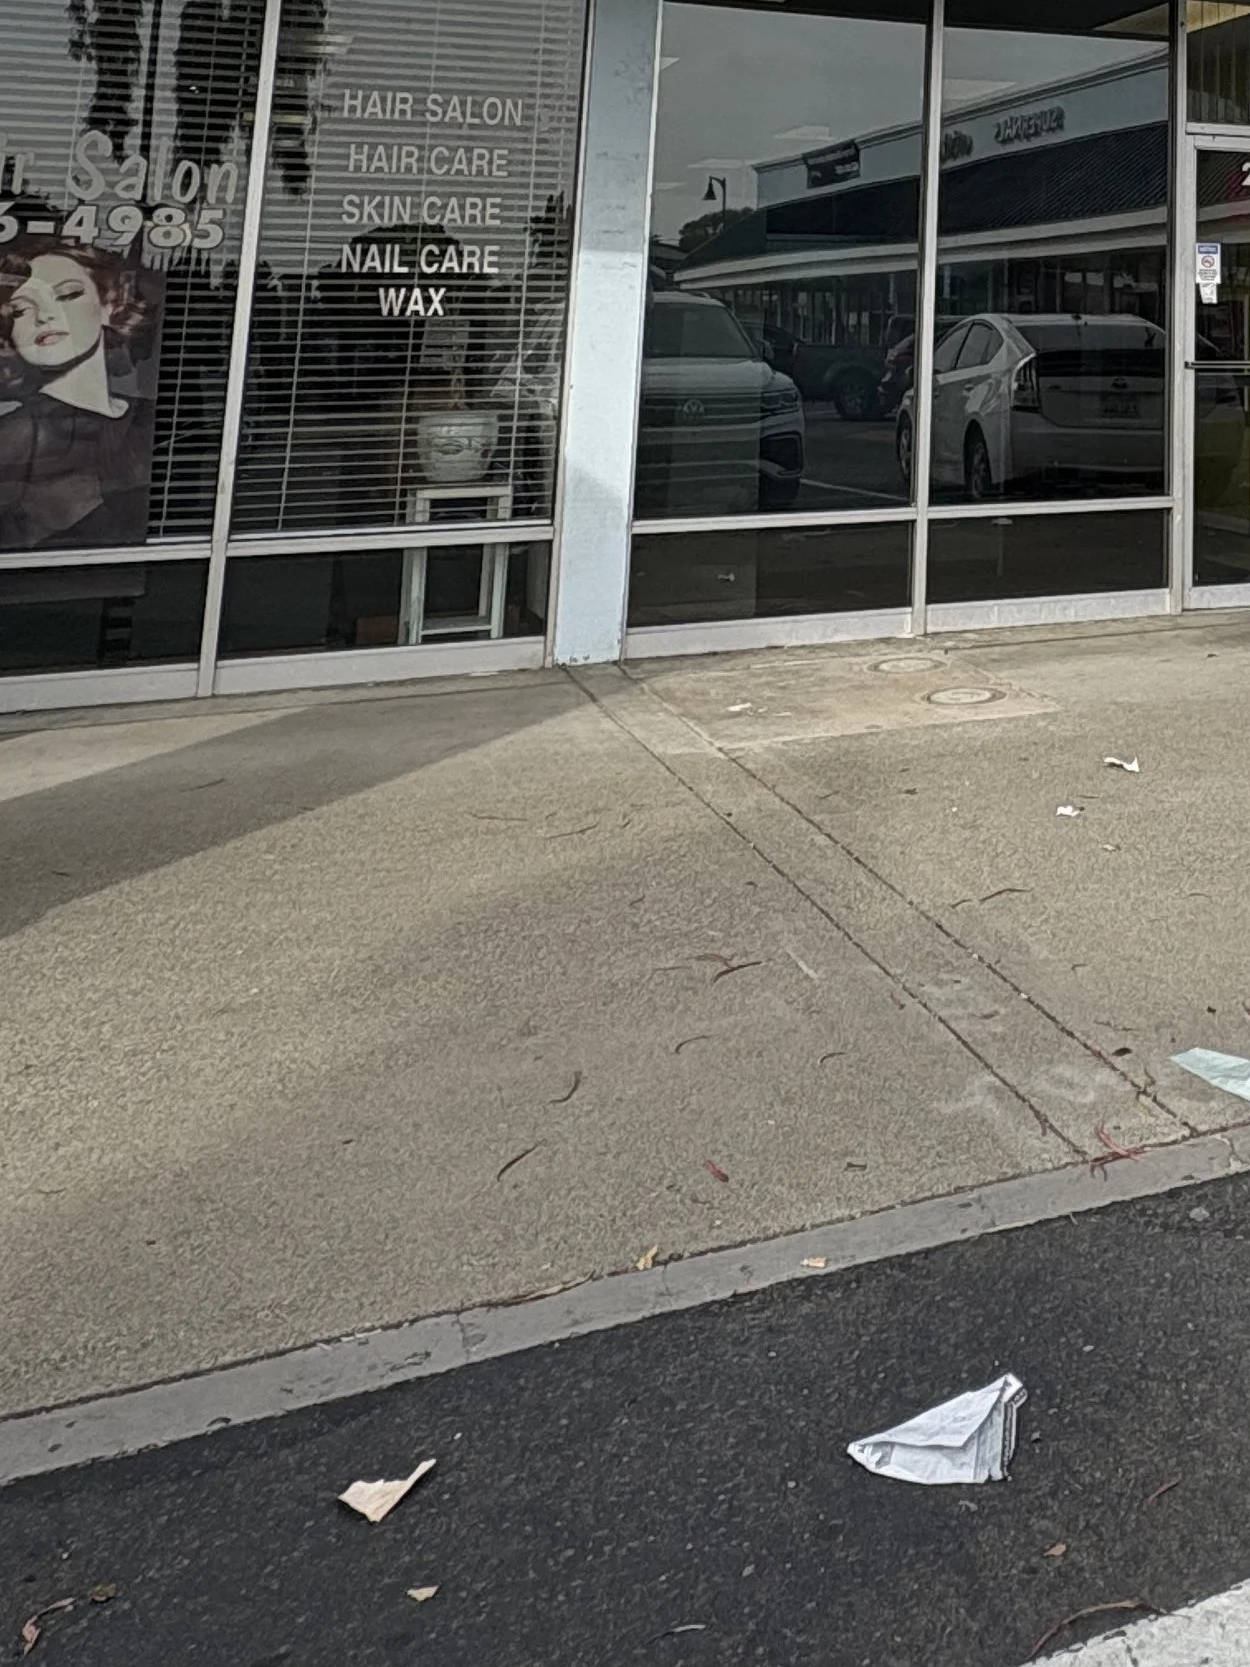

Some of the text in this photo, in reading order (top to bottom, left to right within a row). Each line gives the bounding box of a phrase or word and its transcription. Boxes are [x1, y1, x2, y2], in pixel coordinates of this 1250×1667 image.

[343, 89, 523, 125] HAIR SALON
[68, 130, 238, 203] Salon
[348, 144, 508, 176] HAIR CARE
[342, 195, 501, 225] SKIN CARE
[341, 244, 500, 273] NAIL CARE
[379, 288, 446, 316] WAX
